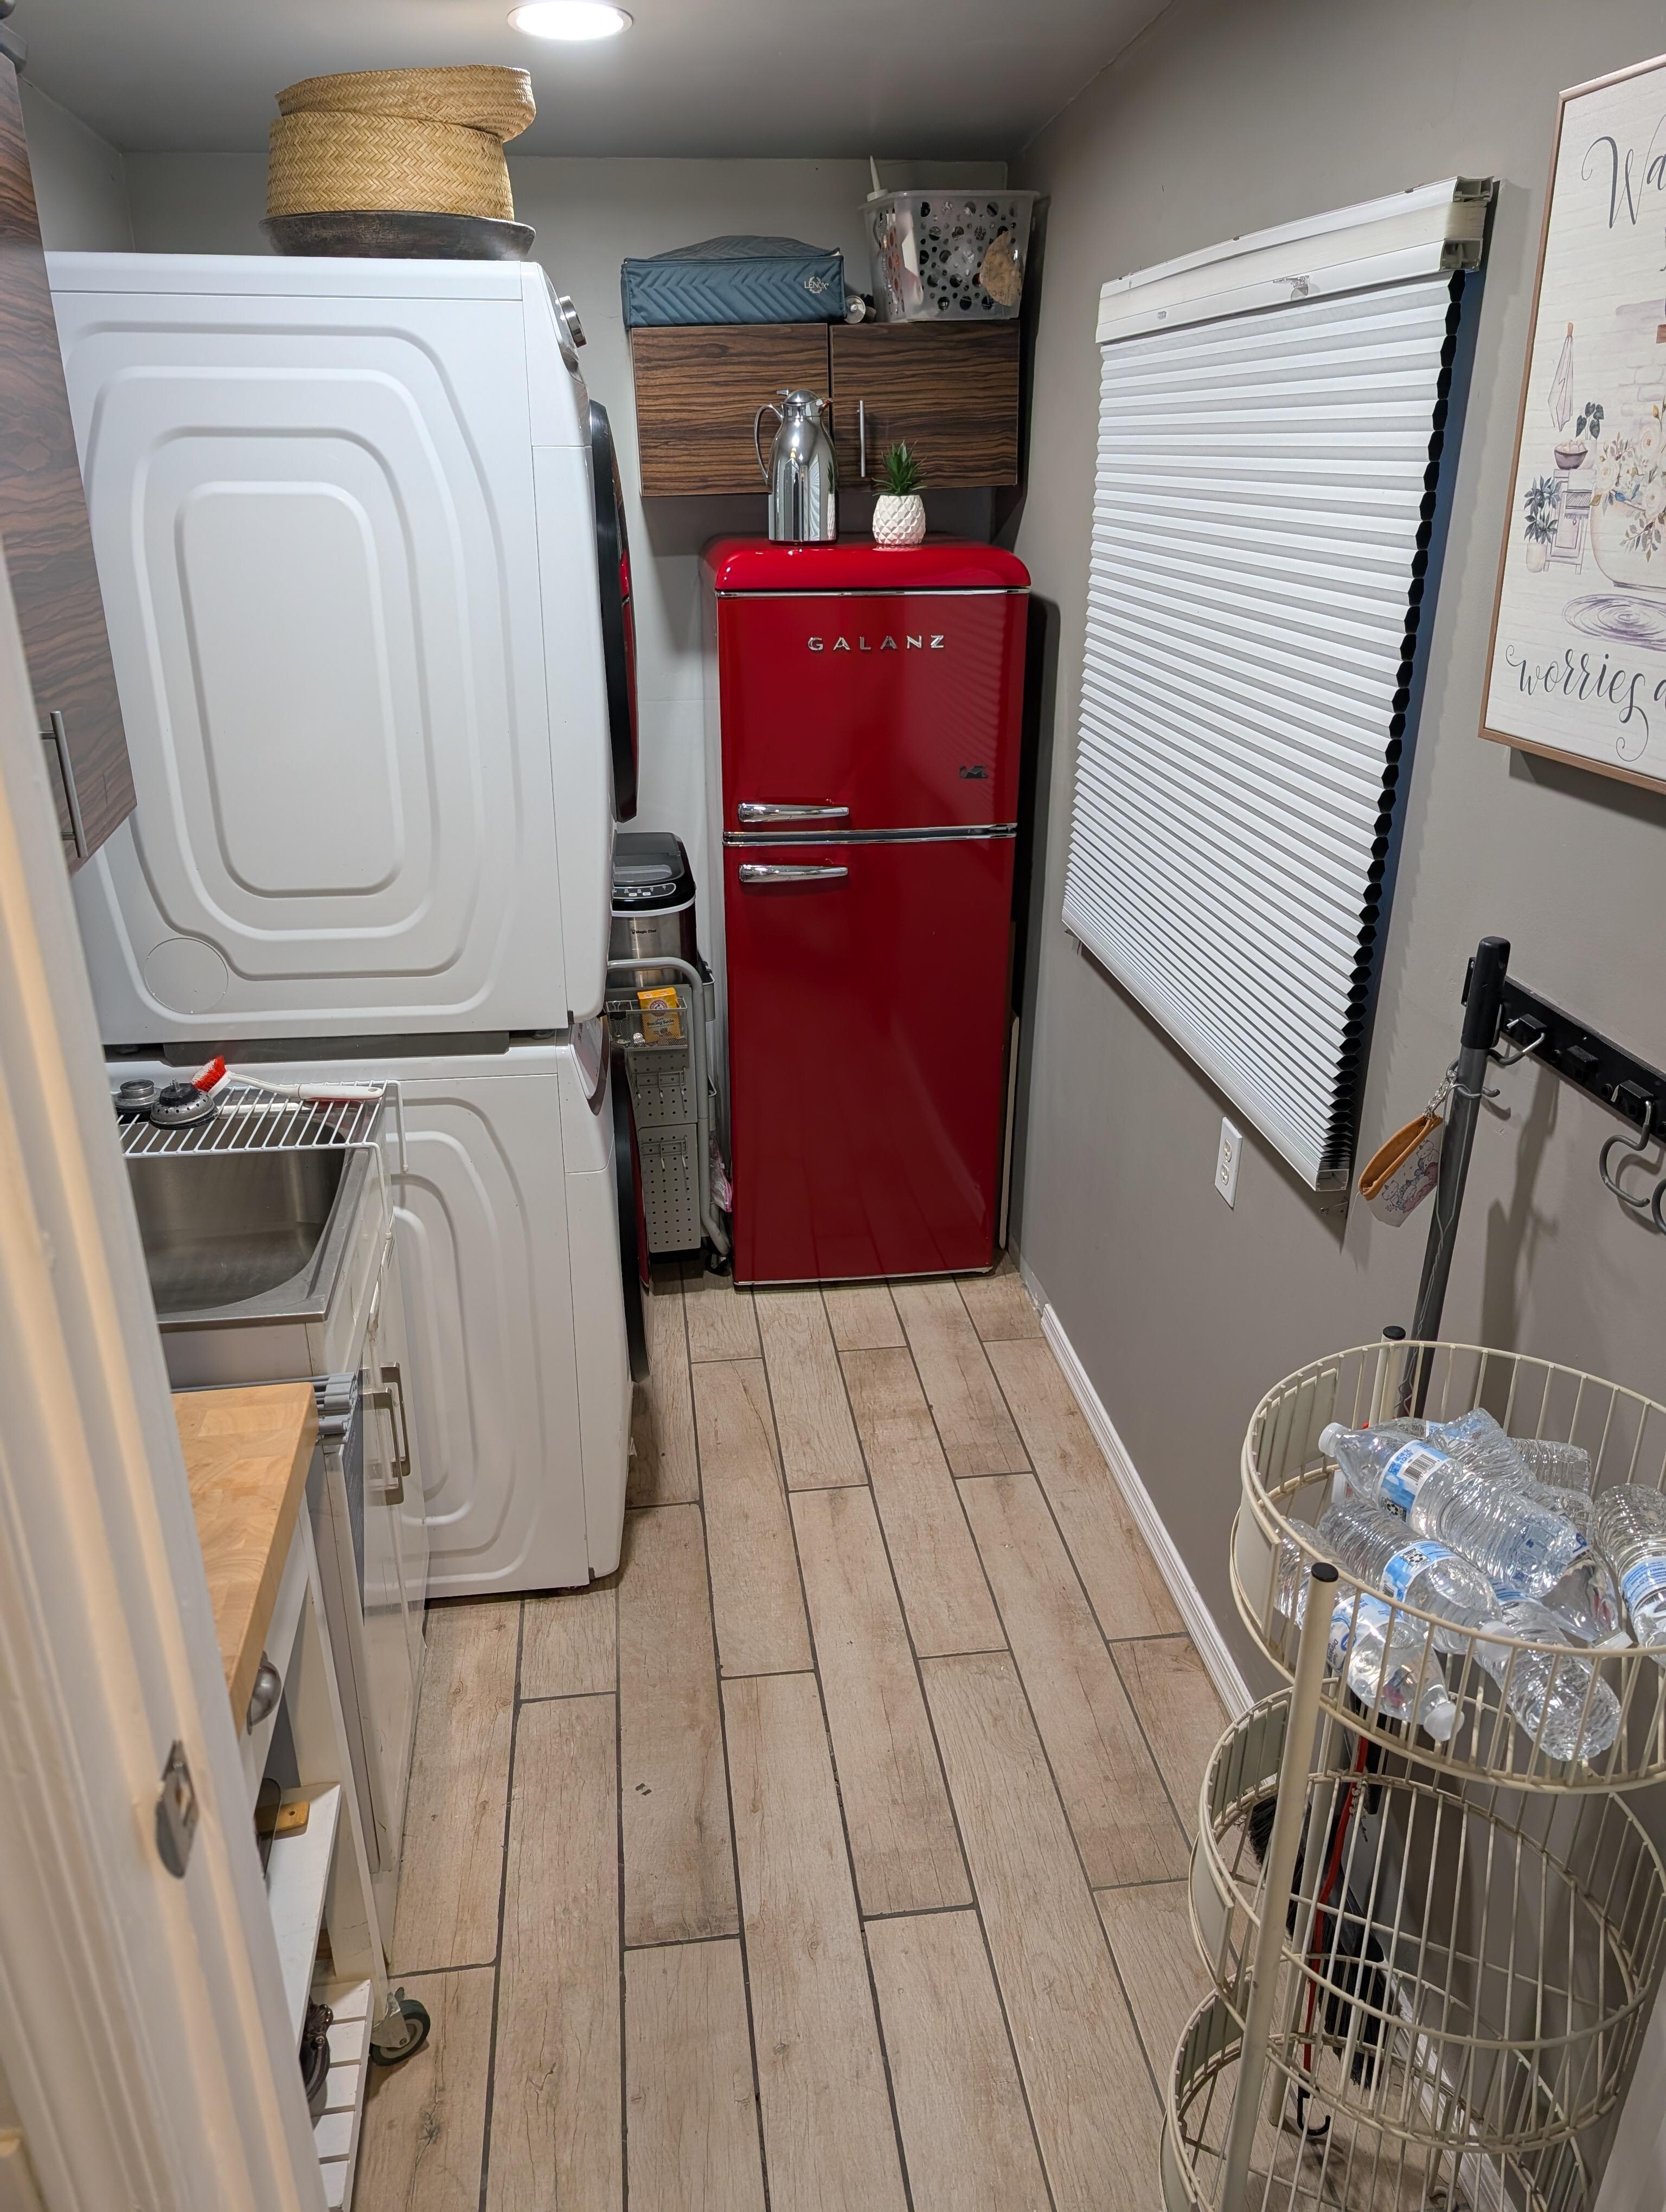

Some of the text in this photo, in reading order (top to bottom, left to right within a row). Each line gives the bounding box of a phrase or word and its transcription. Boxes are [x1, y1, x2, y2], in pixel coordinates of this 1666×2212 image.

[804, 281, 828, 290] LENOX
[808, 635, 945, 651] GALANZ
[1505, 645, 1649, 762] worries
